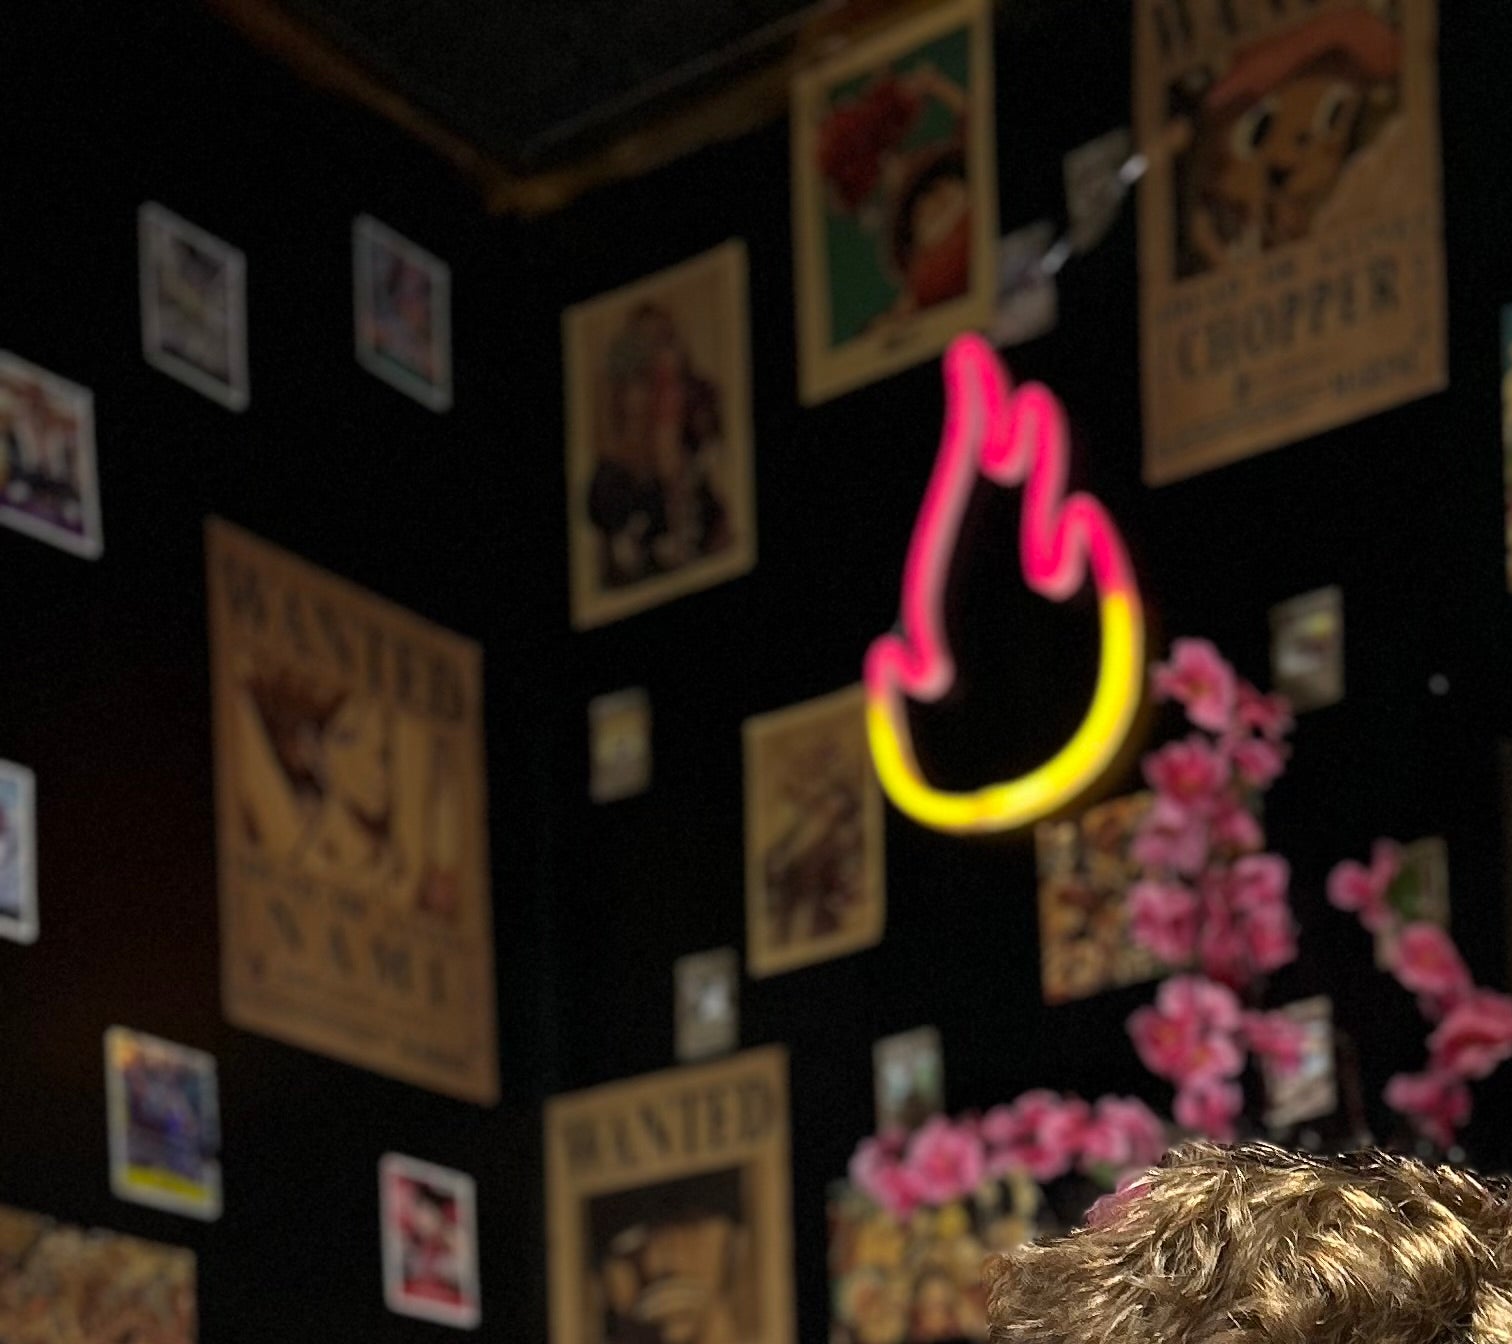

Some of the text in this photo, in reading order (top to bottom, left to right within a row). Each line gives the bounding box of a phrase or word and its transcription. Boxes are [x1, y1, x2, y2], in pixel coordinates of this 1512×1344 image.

[1174, 253, 1401, 380] CHOPPER
[224, 553, 468, 725] WANTED
[560, 1077, 783, 1170] WANTED
